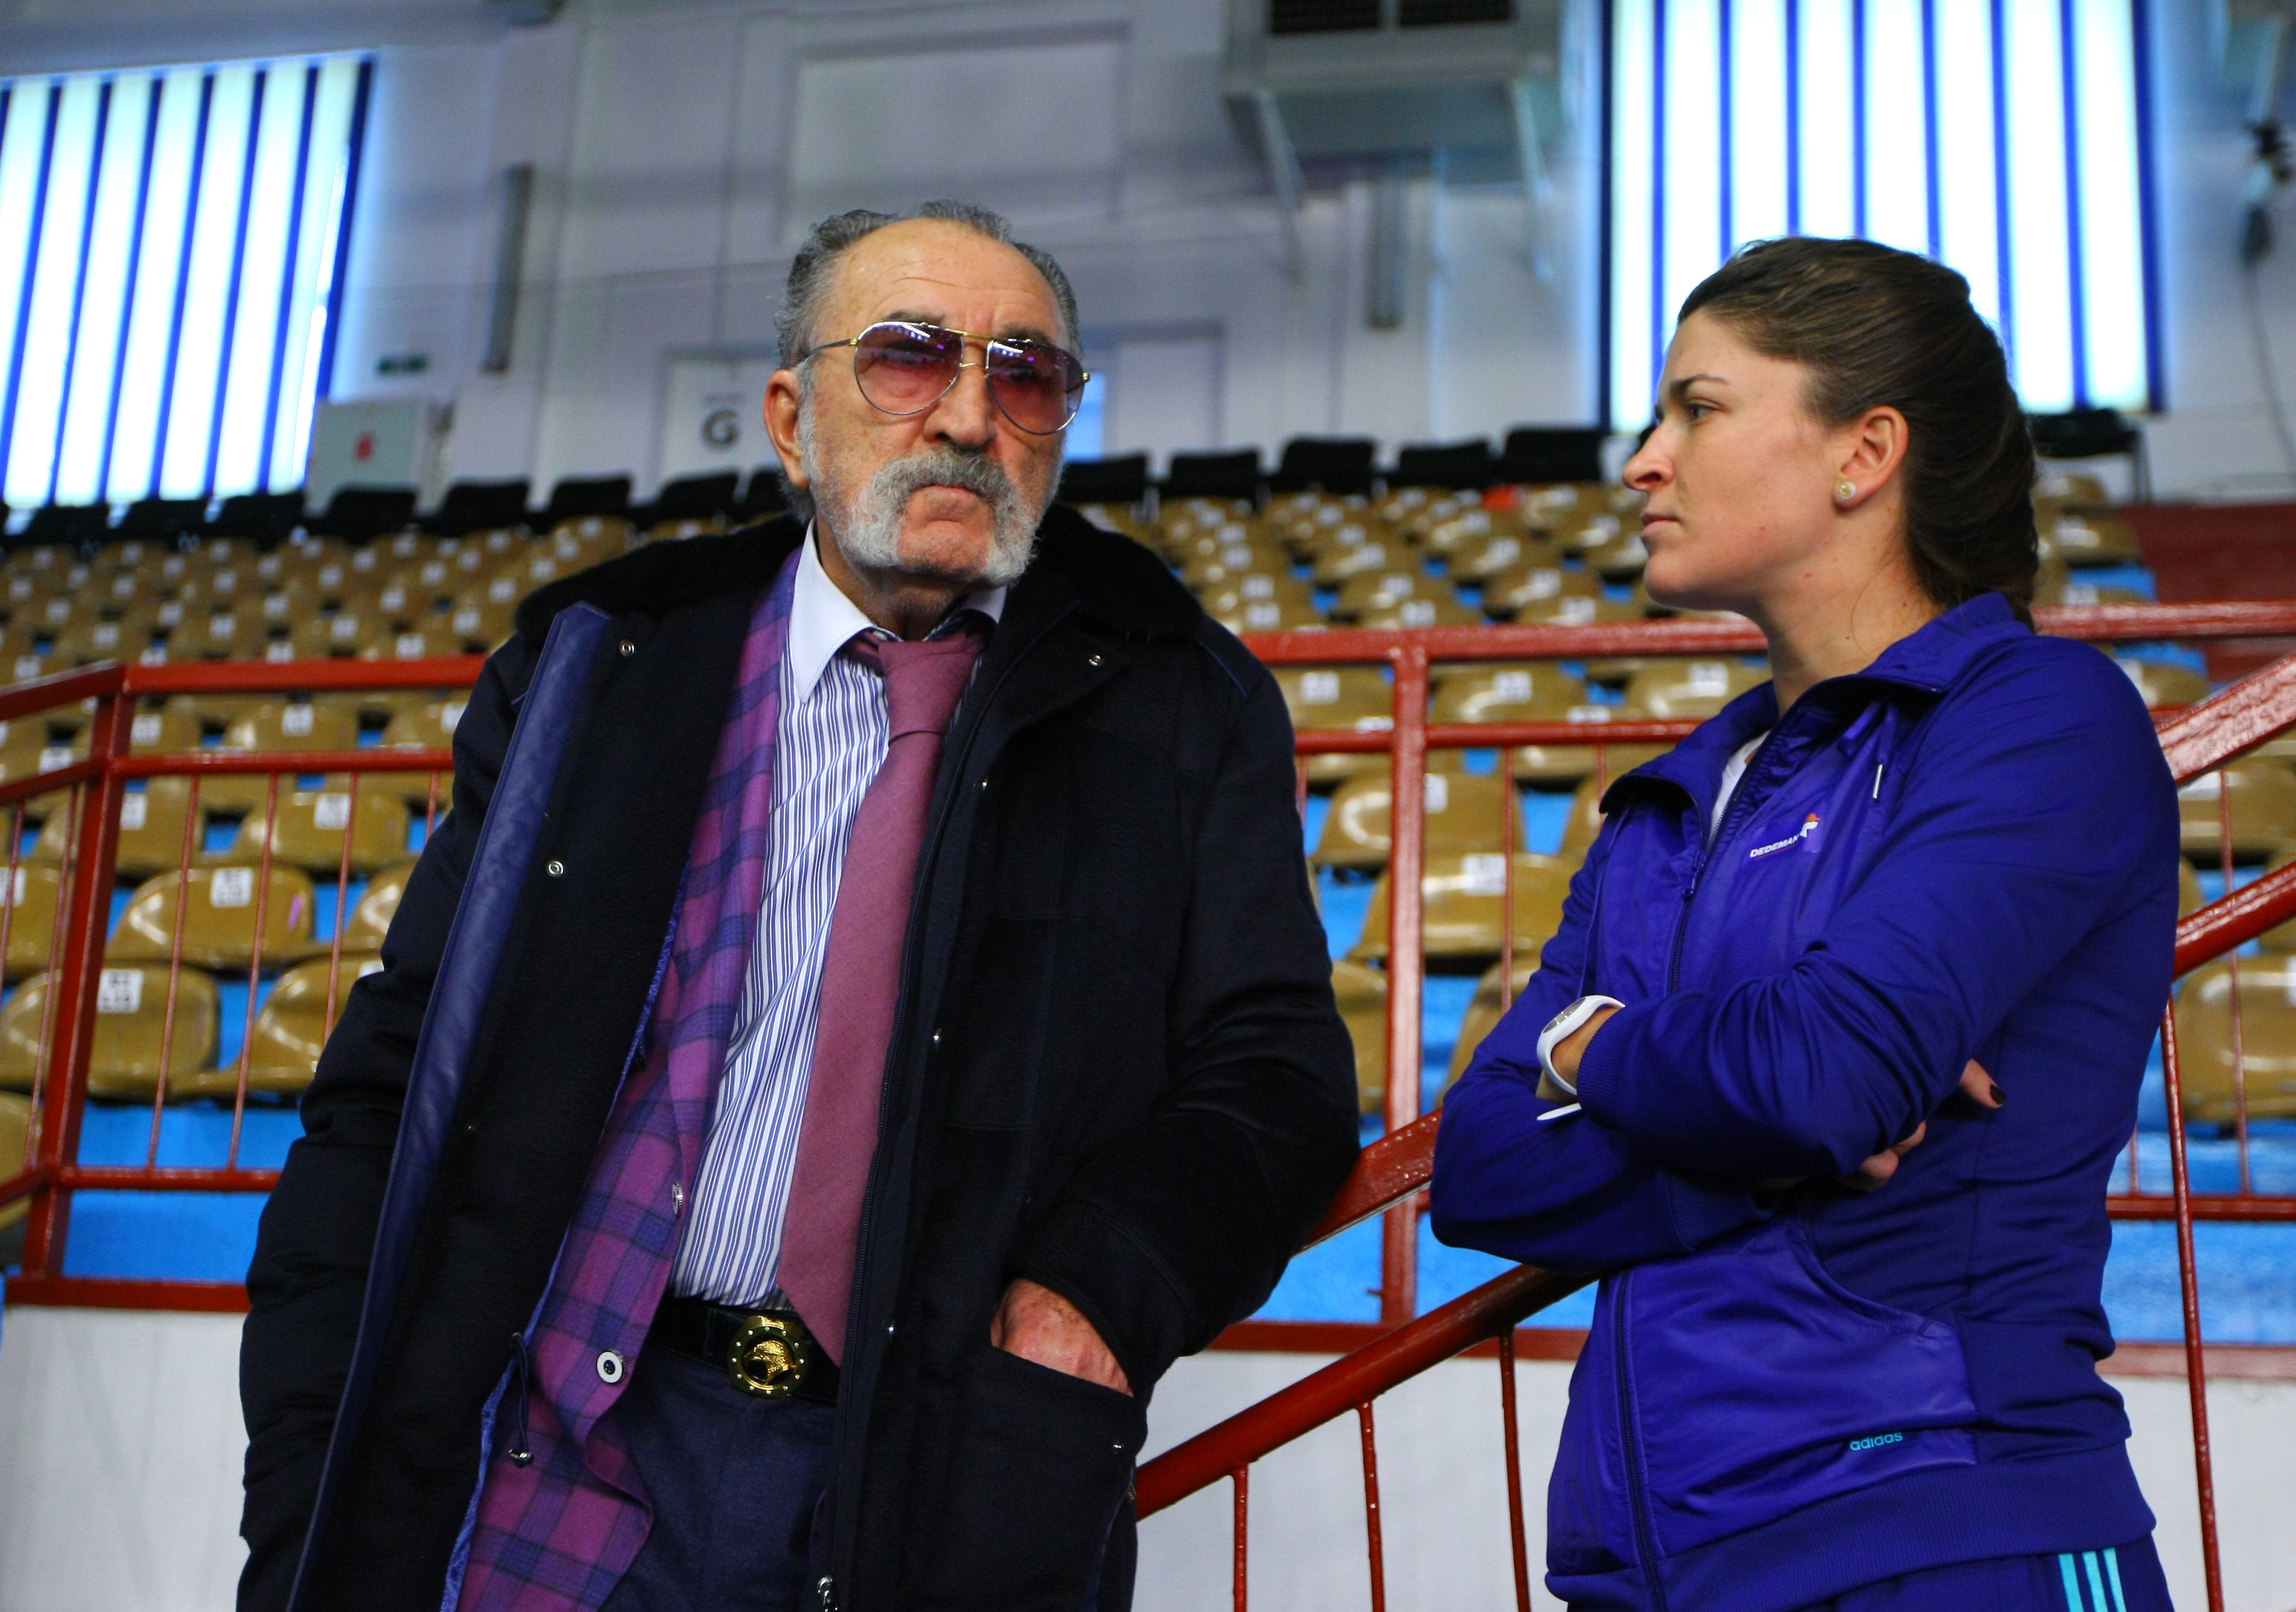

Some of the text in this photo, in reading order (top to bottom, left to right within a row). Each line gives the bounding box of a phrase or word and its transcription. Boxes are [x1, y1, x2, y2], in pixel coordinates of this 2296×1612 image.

[702, 408, 740, 452] G
[1750, 833, 1800, 857] DEDEMAN
[1850, 1432, 1903, 1451] adidas
